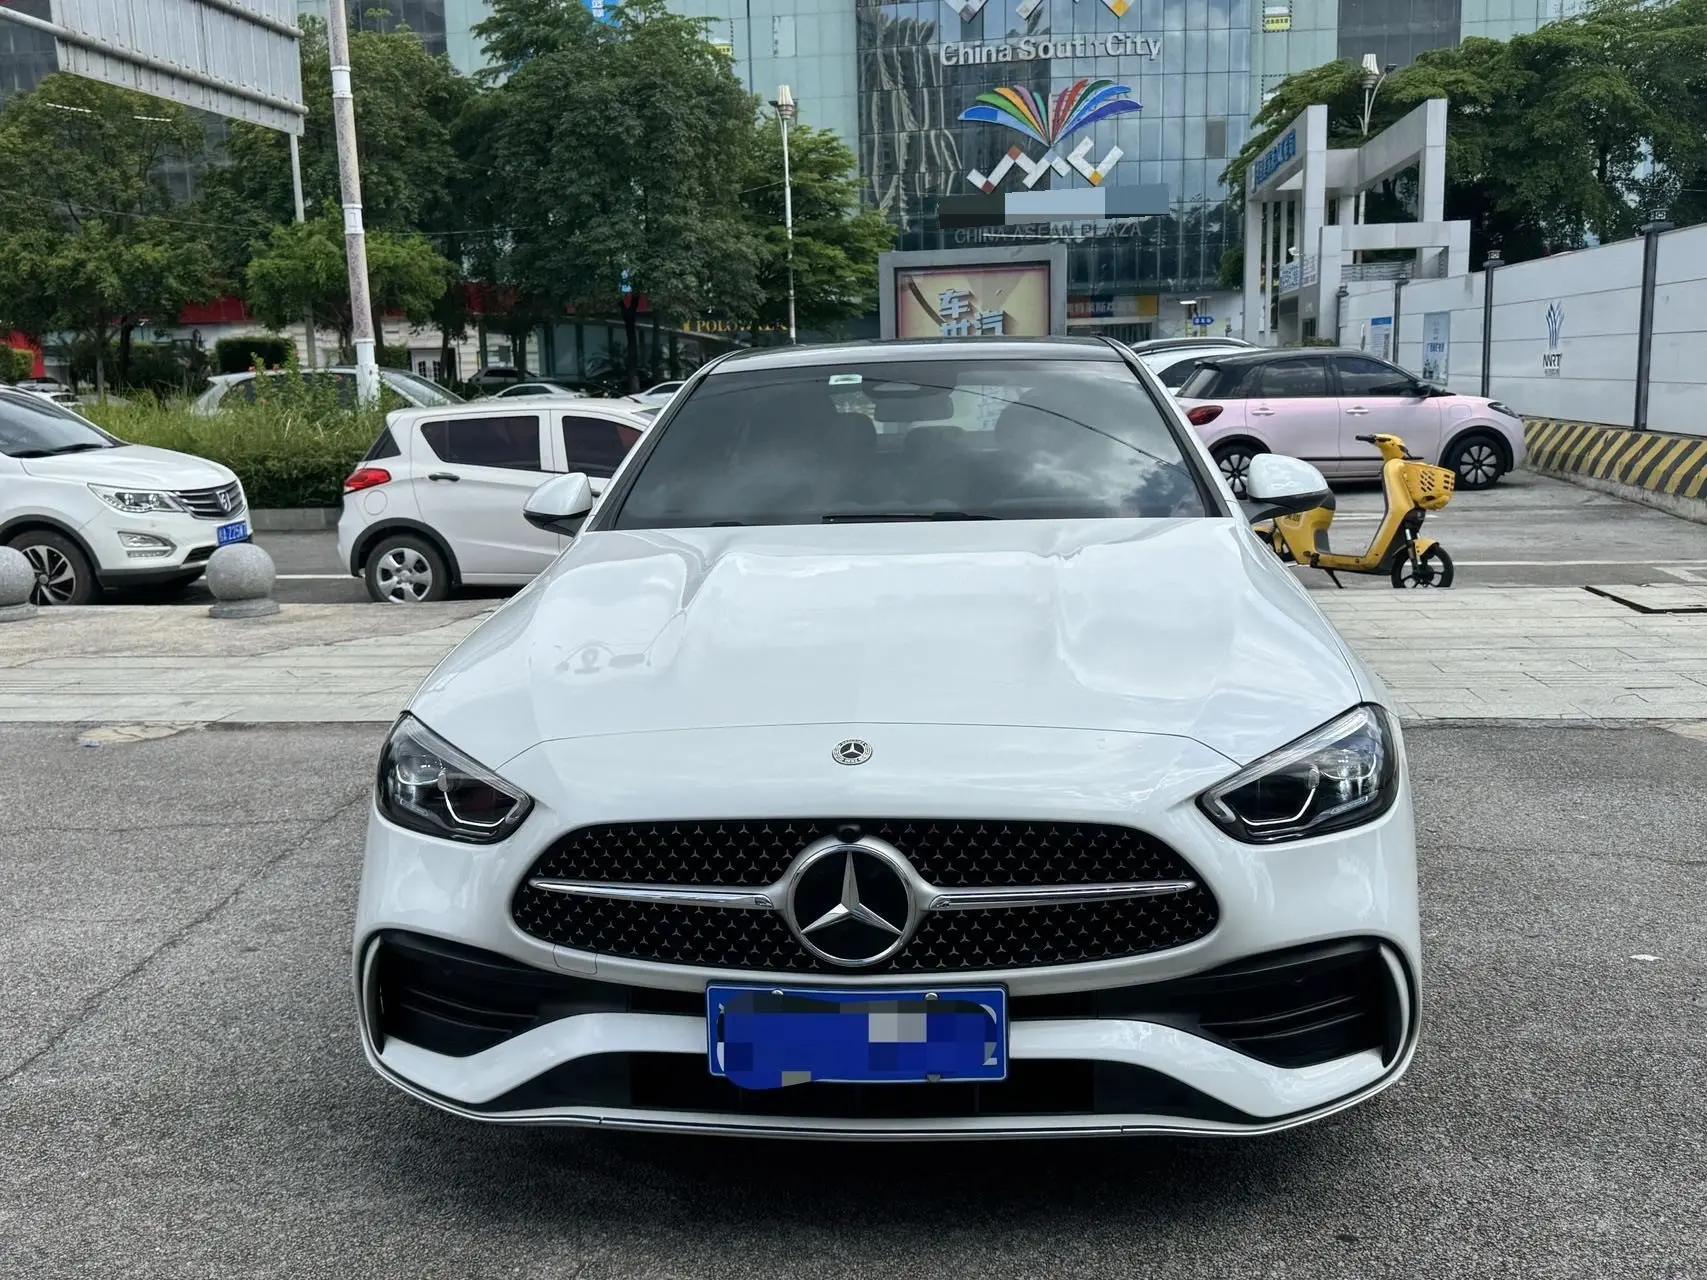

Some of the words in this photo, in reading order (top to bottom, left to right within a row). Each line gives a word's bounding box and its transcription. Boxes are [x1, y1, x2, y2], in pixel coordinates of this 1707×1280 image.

[940, 40, 1012, 66] China
[1018, 35, 1101, 61] South
[1105, 32, 1162, 61] City
[954, 227, 1006, 244] CHINA
[1013, 223, 1074, 241] ASEAN
[1081, 222, 1143, 239] PLAZA
[938, 288, 973, 319] 车
